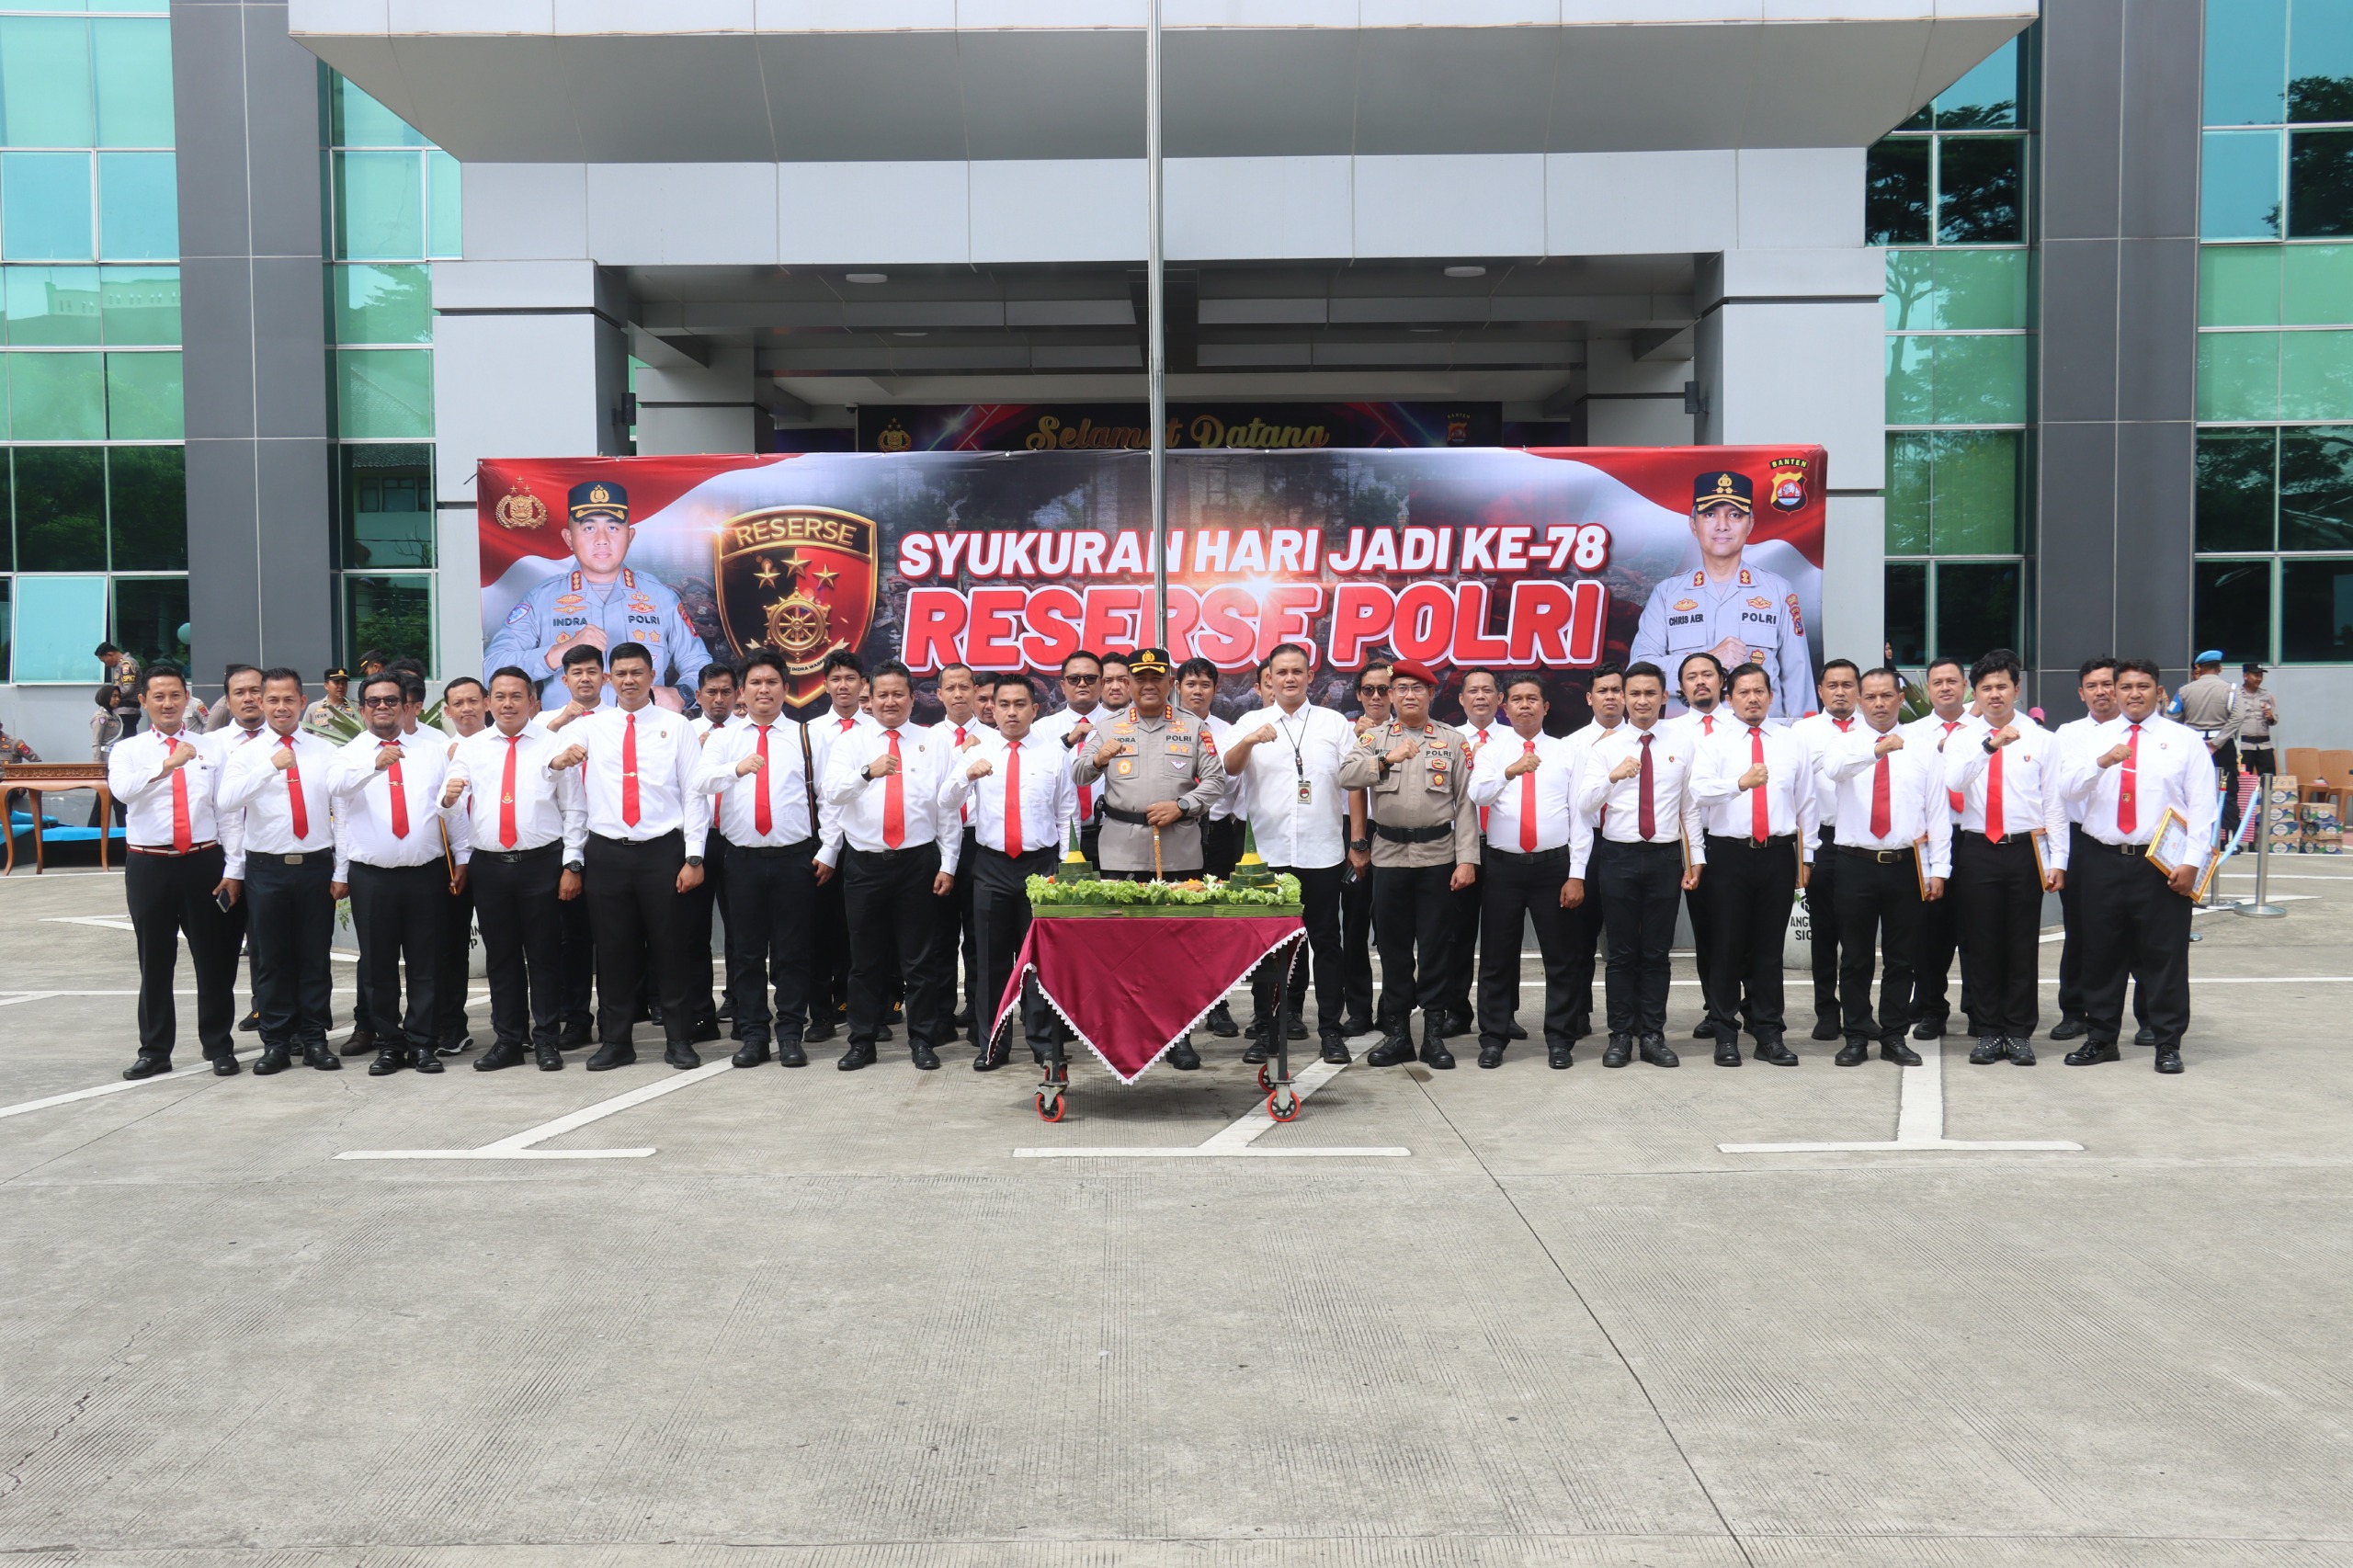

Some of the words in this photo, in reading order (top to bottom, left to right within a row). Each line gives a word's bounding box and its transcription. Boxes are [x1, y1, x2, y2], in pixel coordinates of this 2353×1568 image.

[1025, 415, 1183, 449] Selamt
[1770, 459, 1809, 469] BANTEN
[734, 517, 858, 548] RESERSE
[899, 530, 1185, 576] SYUKURAN
[1194, 528, 1319, 573] HARI
[1327, 527, 1452, 572] JADI
[1461, 525, 1607, 570] KE-78
[552, 618, 588, 626] INDRA
[628, 615, 661, 625] POLRI
[902, 583, 1324, 671] RESERSE
[1329, 580, 1604, 666] POLRI
[1668, 615, 1689, 627] CHRIS
[1690, 613, 1704, 624] AER
[1741, 612, 1777, 625] POLRI
